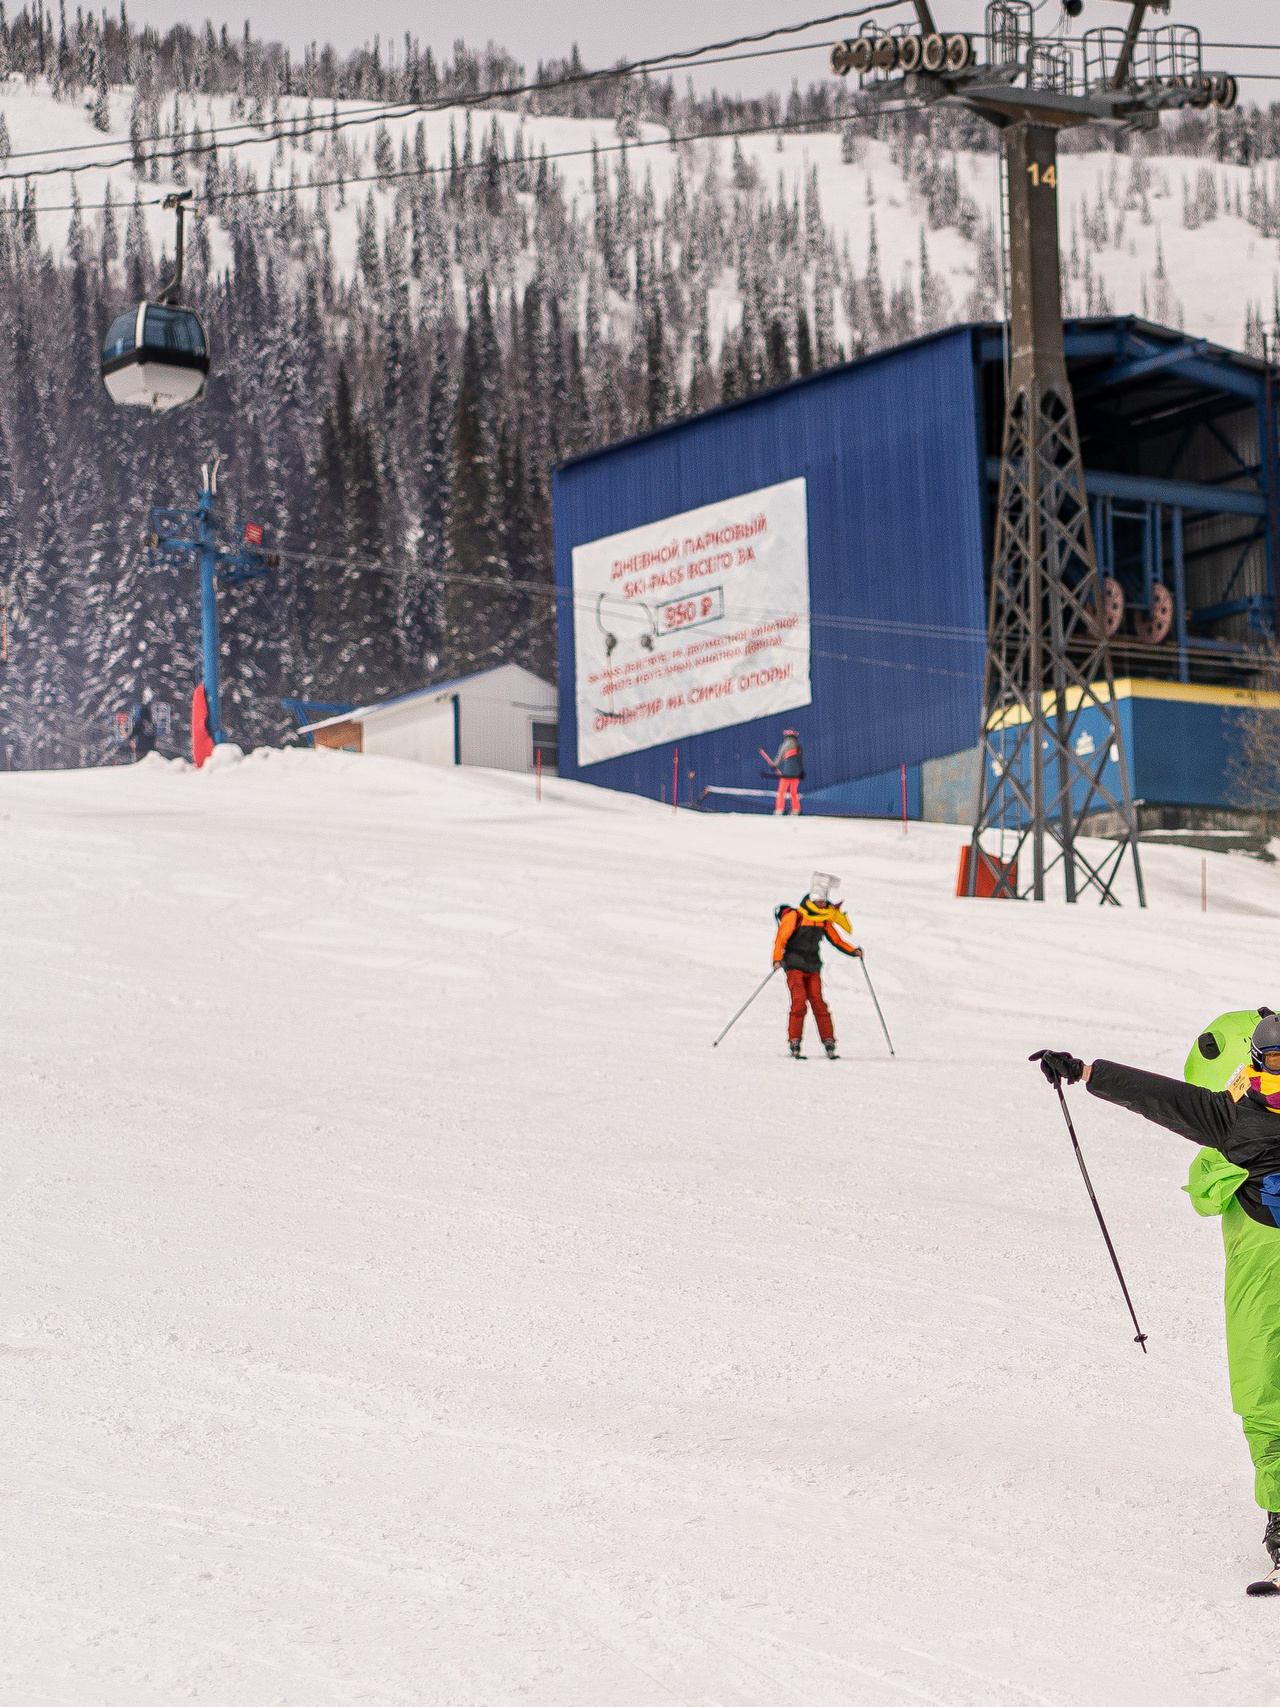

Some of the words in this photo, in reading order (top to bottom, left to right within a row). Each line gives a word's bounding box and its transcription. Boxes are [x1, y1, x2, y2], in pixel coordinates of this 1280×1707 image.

[1026, 162, 1057, 189] 14
[610, 539, 679, 581] ДНЕВНОЙ
[683, 512, 767, 556] ПАРКОВЫЙ
[623, 564, 684, 598] SKI-PASS
[687, 552, 733, 580] ВСЕГО
[737, 545, 756, 566] ЗА
[664, 601, 697, 629] 950
